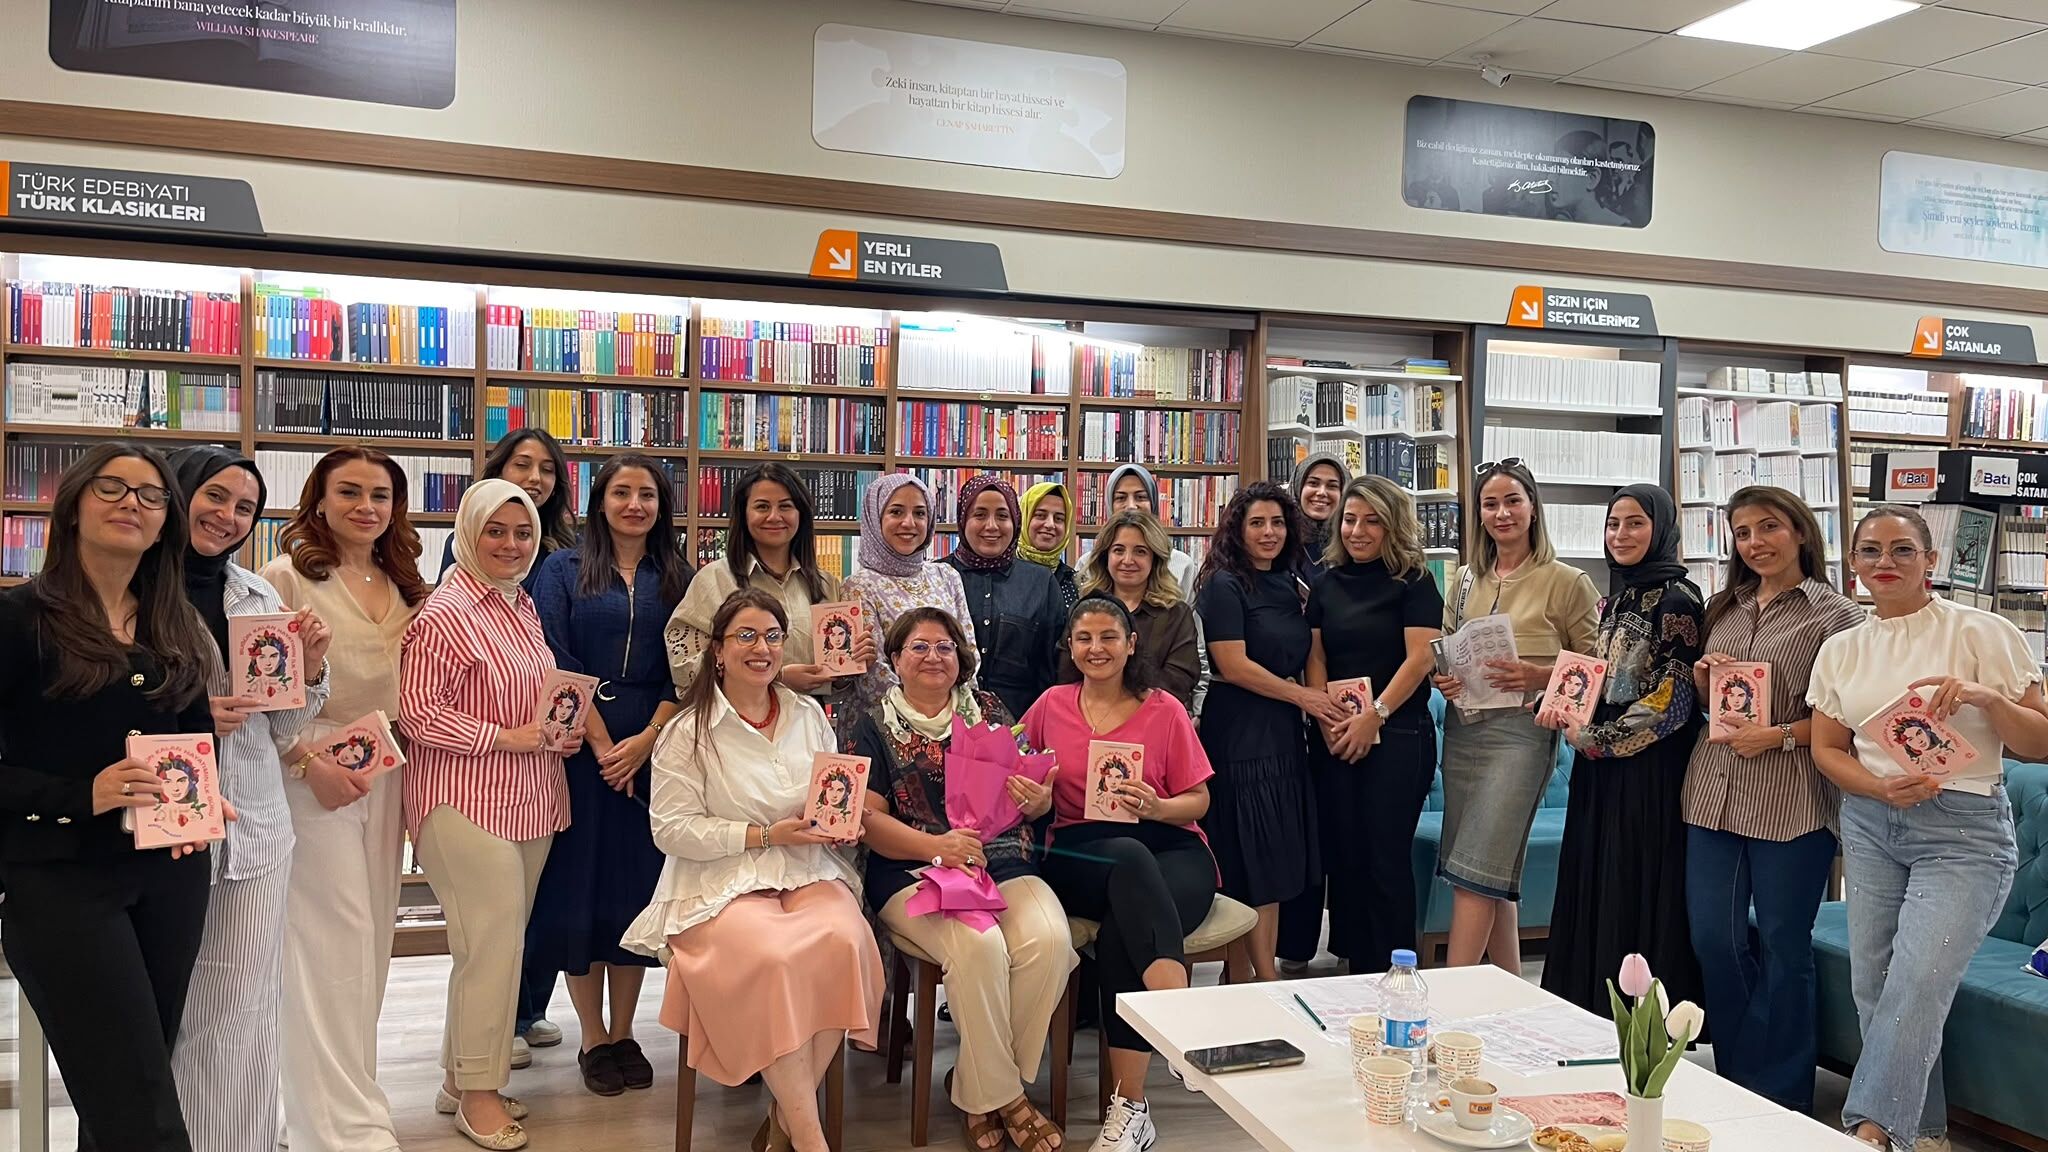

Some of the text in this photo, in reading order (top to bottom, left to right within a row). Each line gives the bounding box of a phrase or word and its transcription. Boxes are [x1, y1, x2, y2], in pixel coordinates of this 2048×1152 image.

[174, 0, 203, 12] bana
[206, 3, 253, 18] yetecek
[255, 6, 291, 23] kadar
[293, 11, 331, 28] büyük
[334, 15, 351, 30] bir
[353, 18, 407, 36] krallıktır.
[196, 21, 318, 44] WILLIAM SHAKESPEARE
[886, 76, 1065, 108] Zeki insan, kitaptan bir hayat hissesi ve
[909, 94, 950, 109] hayattan
[951, 98, 966, 111] bir
[967, 101, 991, 116] kitap
[992, 104, 1023, 118] hissesi
[18, 172, 189, 201] TÜRK EDEBİYATI
[17, 191, 206, 222] TÜRK KLASİKLERİ
[864, 241, 911, 258] YERLİ
[864, 260, 942, 279] EN İYİLER
[1547, 295, 1608, 311] SİZİN İÇİN
[1547, 311, 1640, 329] SEÇTİKLERİMİZ
[1946, 325, 1970, 338] ÇOK
[1945, 341, 2002, 355] SATANLAR
[1906, 473, 1929, 484] Batı
[1983, 472, 2010, 485] Batı
[2018, 472, 2038, 486] ÇOK
[2017, 487, 2048, 499] SATAN
